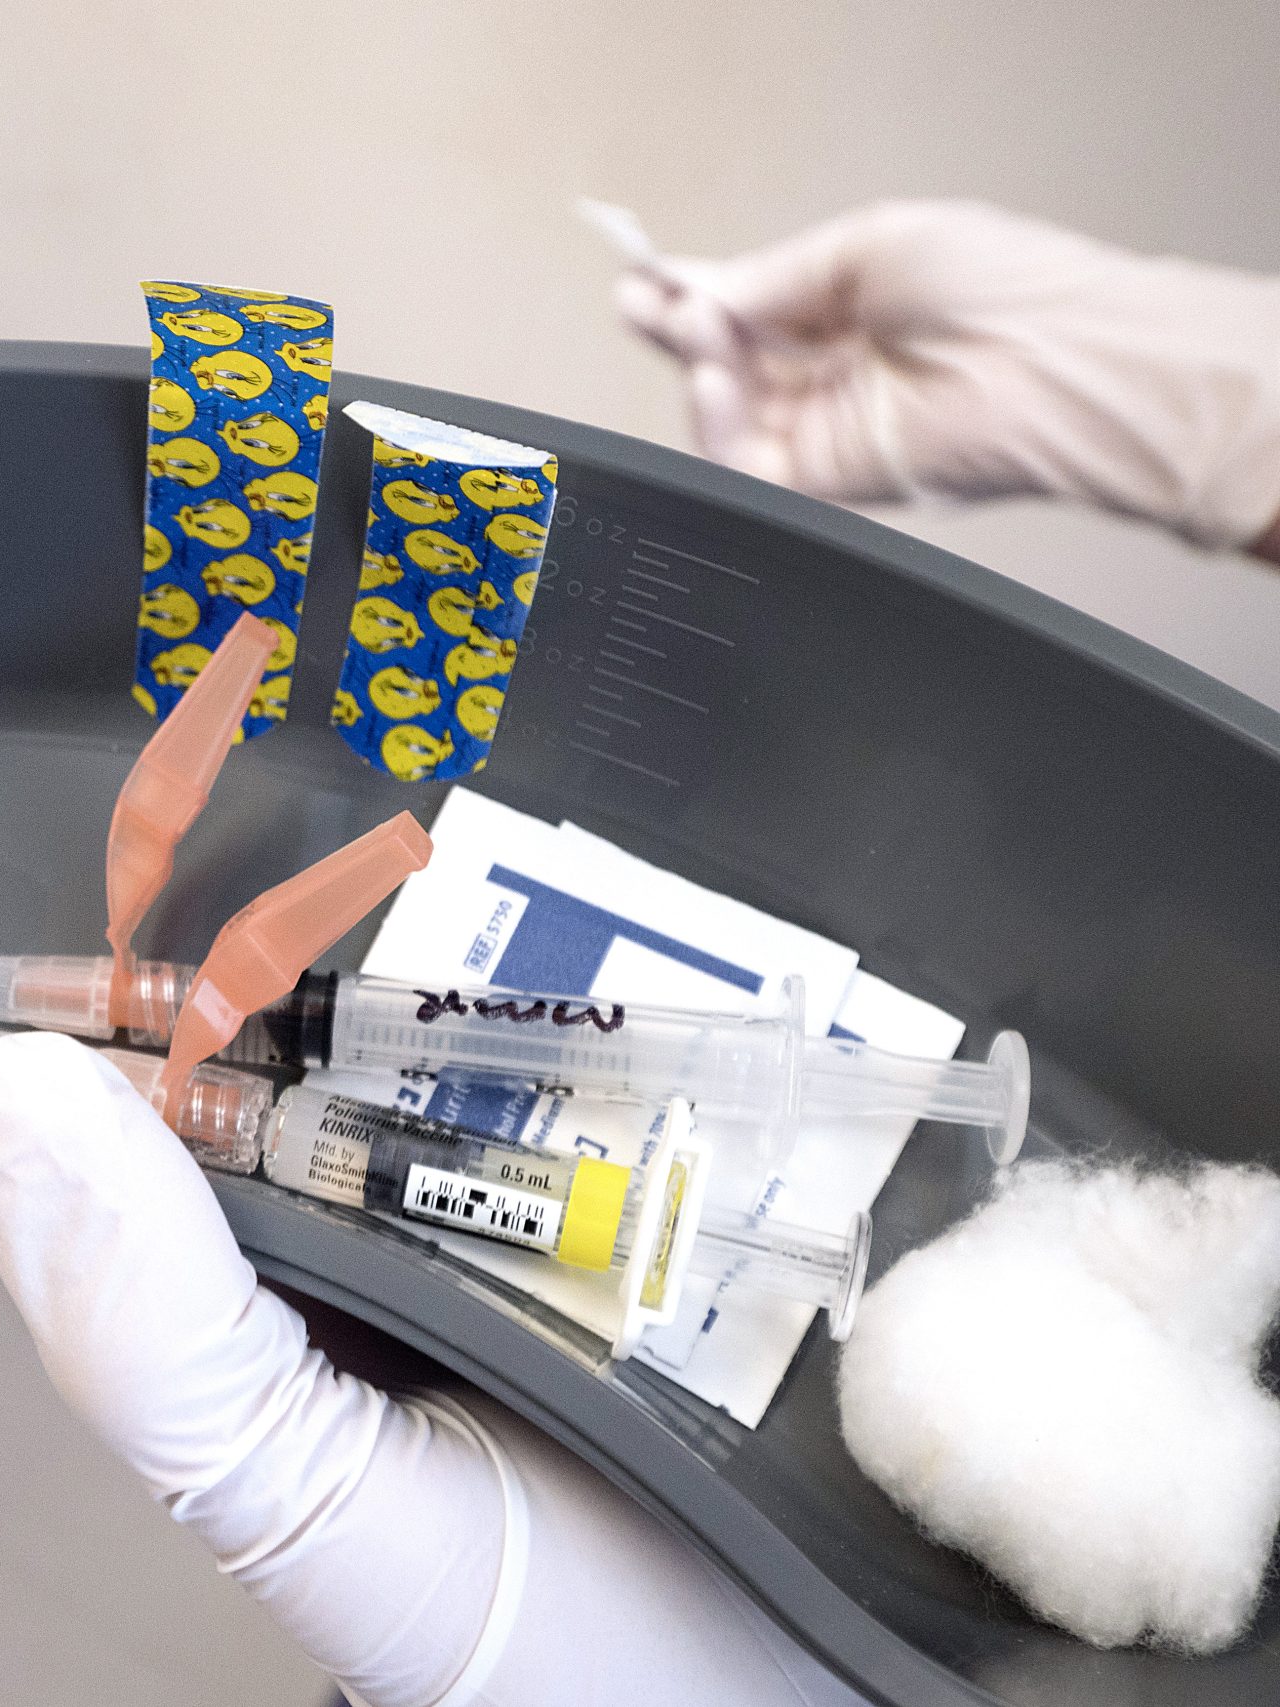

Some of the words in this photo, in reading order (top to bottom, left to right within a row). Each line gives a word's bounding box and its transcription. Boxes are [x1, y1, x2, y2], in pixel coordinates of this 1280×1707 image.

[325, 1102, 398, 1131] Poliovirus
[340, 1146, 356, 1162] by
[500, 1164, 525, 1184] 0.5
[528, 1174, 552, 1191] mL
